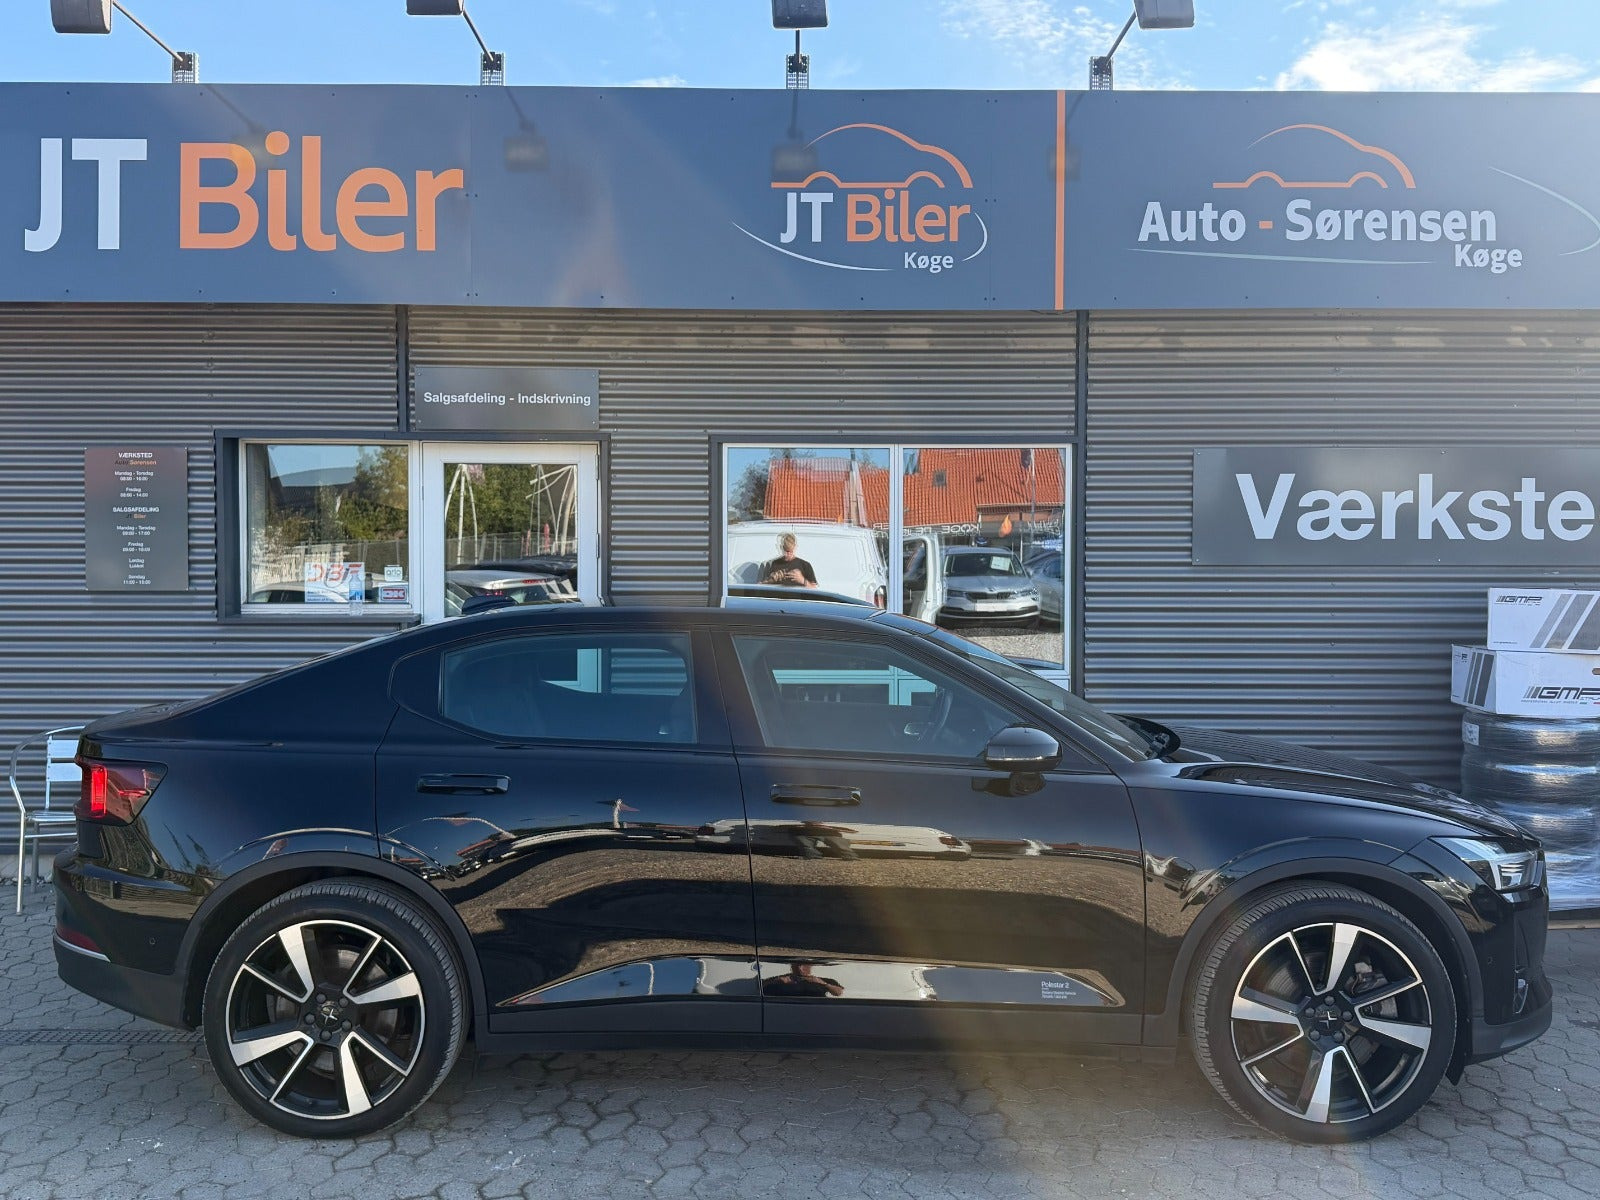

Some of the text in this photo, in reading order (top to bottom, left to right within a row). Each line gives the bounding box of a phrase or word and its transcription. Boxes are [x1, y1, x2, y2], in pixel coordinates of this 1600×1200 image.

[24, 130, 464, 252] JT Biler
[780, 188, 971, 244] JT Biler
[1138, 198, 1497, 242] Auto - Sørensen
[904, 252, 954, 273] Køge
[1454, 243, 1523, 274] Køge
[423, 392, 506, 405] Salgsafdeling
[518, 392, 591, 406] Indskrivning
[1235, 473, 1596, 541] Værkste
[1503, 595, 1543, 603] GMP
